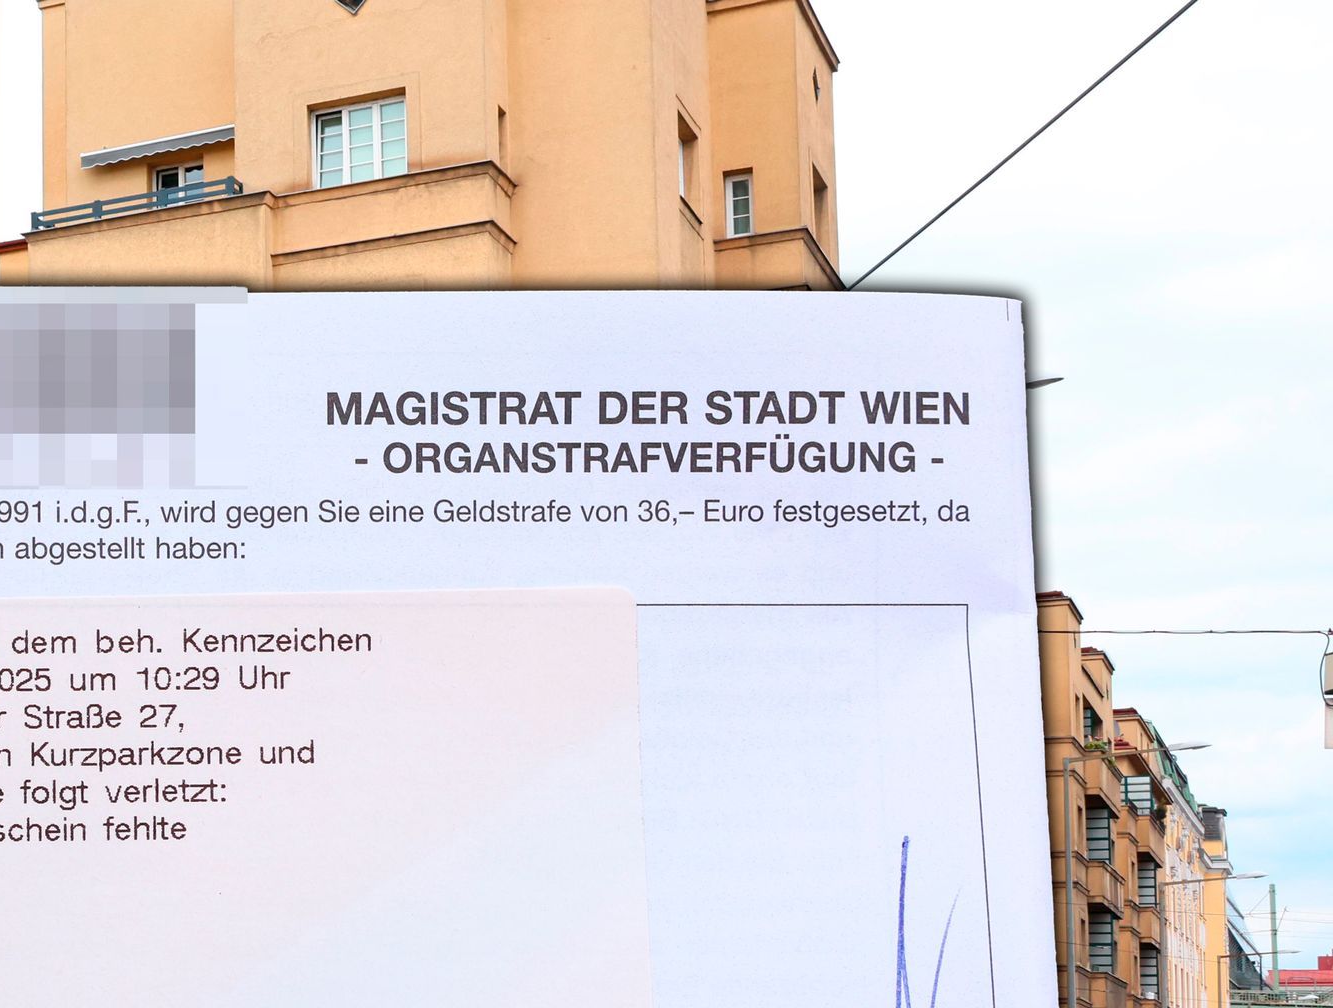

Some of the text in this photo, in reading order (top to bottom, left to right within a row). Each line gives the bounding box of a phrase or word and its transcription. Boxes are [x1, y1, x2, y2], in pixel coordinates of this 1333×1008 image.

[326, 390, 970, 426] MAGISTRAT DER STADT WIEN
[383, 434, 916, 475] ORGANSTRAFVERFÜGUNG
[57, 501, 149, 529] i.d.g.F.,
[161, 501, 215, 522] wird
[227, 506, 307, 529] gegen
[319, 500, 359, 522] Sie
[370, 500, 423, 522] eine
[434, 500, 571, 522] Geldstrafe
[581, 506, 627, 522] von
[705, 500, 763, 522] Euro
[774, 500, 926, 529] festgesetzt,
[938, 500, 970, 522] da
[15, 537, 145, 566] abgestellt
[157, 537, 245, 560] haben:
[12, 630, 76, 655] dem
[97, 629, 161, 654] beh.
[184, 628, 371, 653] Kennzeichen
[71, 673, 115, 692] um
[137, 667, 219, 691] 10:29
[240, 665, 290, 690] Uhr
[25, 704, 121, 730] Straße
[140, 704, 184, 733] 27,
[31, 742, 241, 773] Kurzparkzone
[260, 742, 314, 765] und
[20, 780, 88, 811] folgt
[105, 780, 226, 804] verletzt:
[103, 816, 186, 841] fehlte
